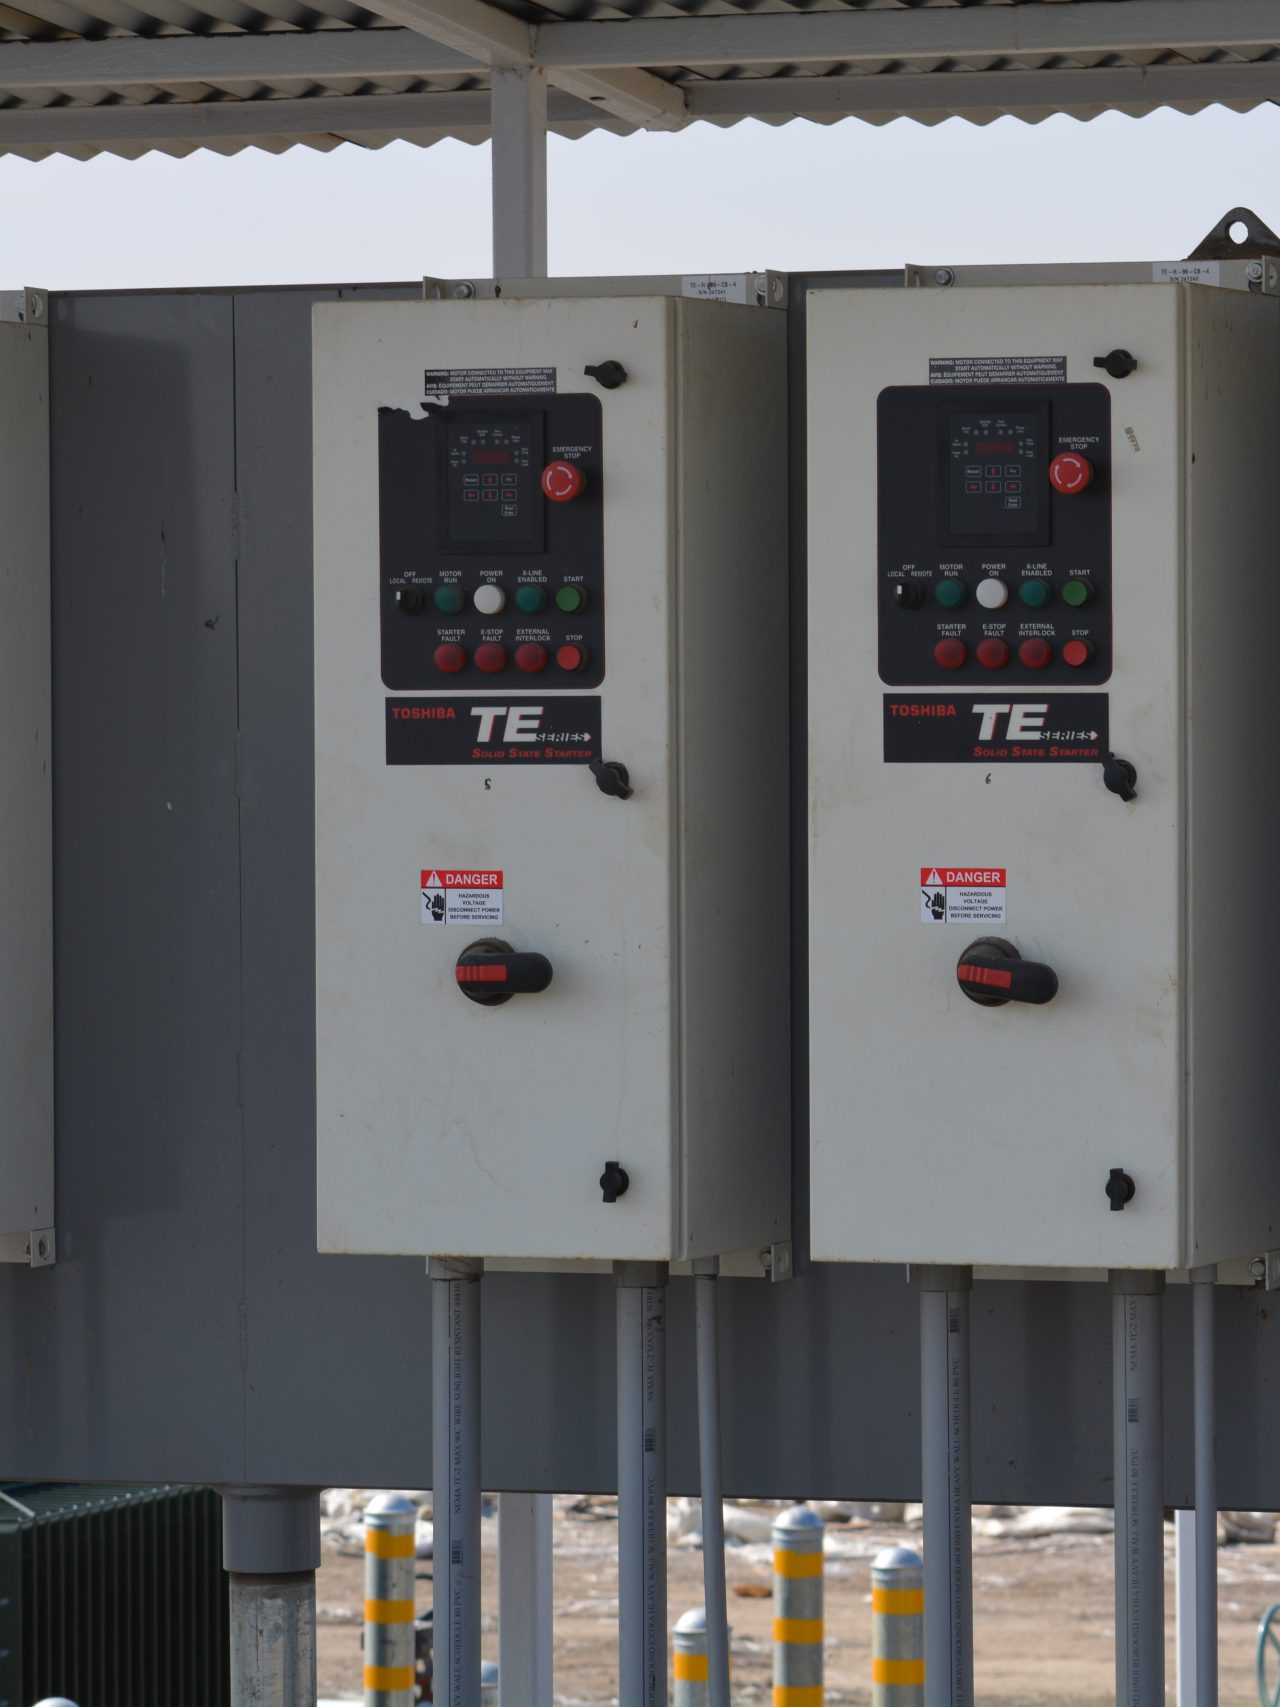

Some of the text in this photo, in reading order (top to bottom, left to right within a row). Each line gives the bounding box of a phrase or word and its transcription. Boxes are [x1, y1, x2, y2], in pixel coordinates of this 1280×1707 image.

[393, 708, 455, 719] TOSHIBA
[891, 705, 956, 716] TOSHIBA
[471, 707, 586, 742] TE SERIES
[972, 704, 1092, 740] TE SERIES
[986, 773, 991, 784] 6
[446, 874, 497, 884] DANGER
[947, 872, 1000, 882] DANGER
